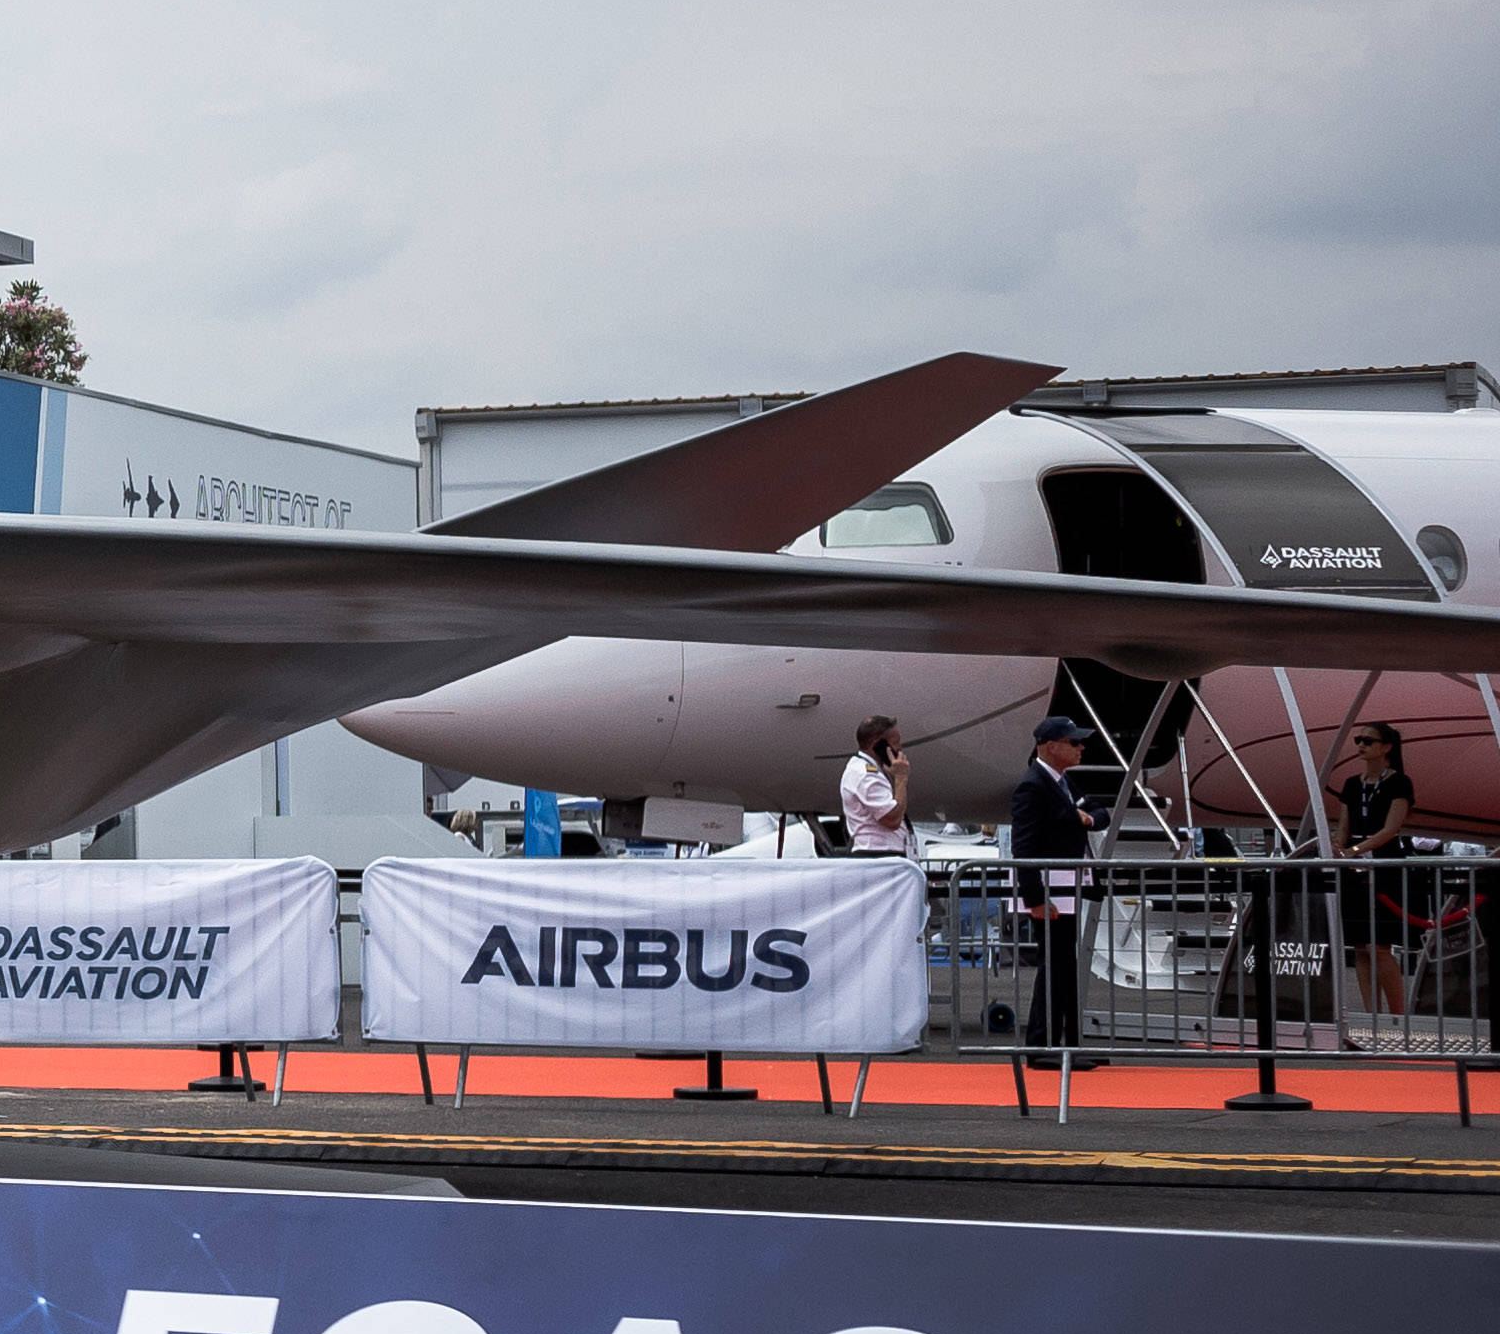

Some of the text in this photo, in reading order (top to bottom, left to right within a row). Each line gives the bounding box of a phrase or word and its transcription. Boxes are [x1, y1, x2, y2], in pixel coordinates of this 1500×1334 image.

[1281, 547, 1382, 558] DASSAULT
[1289, 558, 1382, 569] AVIATION
[461, 925, 810, 993] AIRBUS
